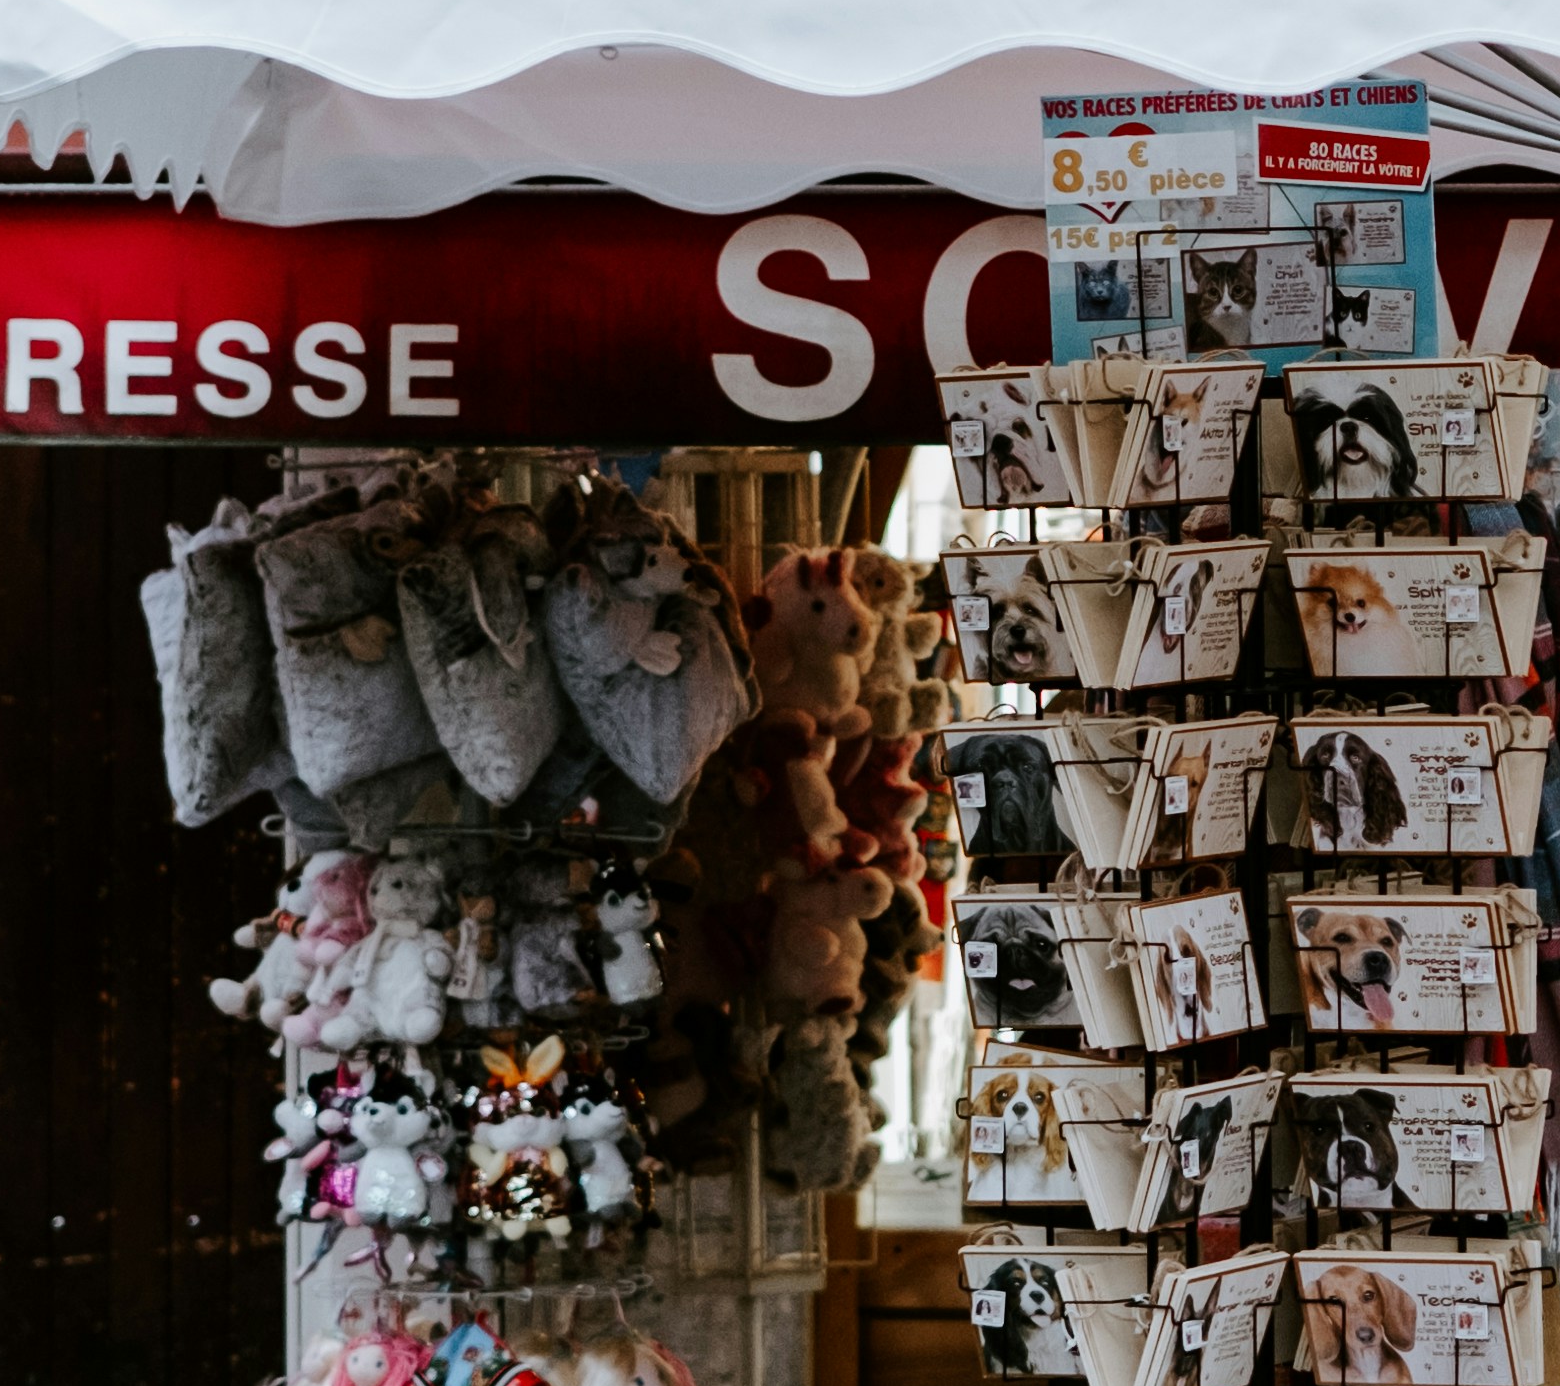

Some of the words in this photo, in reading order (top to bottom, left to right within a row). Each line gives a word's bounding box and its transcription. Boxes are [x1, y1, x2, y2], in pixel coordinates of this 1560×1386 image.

[1043, 99, 1077, 119] VOS
[1083, 96, 1137, 118] RACES
[1141, 89, 1239, 116] PRÉFÉRÉES
[1244, 93, 1266, 112] DE
[1272, 87, 1324, 111] CHATS
[1330, 86, 1351, 107] ET
[1355, 84, 1417, 106] CHIENS
[1309, 141, 1329, 158] 80
[1333, 143, 1378, 162] RACES
[1265, 155, 1275, 168] IL
[1277, 156, 1285, 169] Y
[1287, 157, 1297, 169] A
[1299, 156, 1360, 175] FORCÉMENT
[1362, 162, 1376, 175] LA
[1378, 160, 1413, 178] VÔTRE
[1150, 167, 1226, 196] pièce
[1050, 226, 1100, 250] 15€
[1161, 223, 1180, 246] 2
